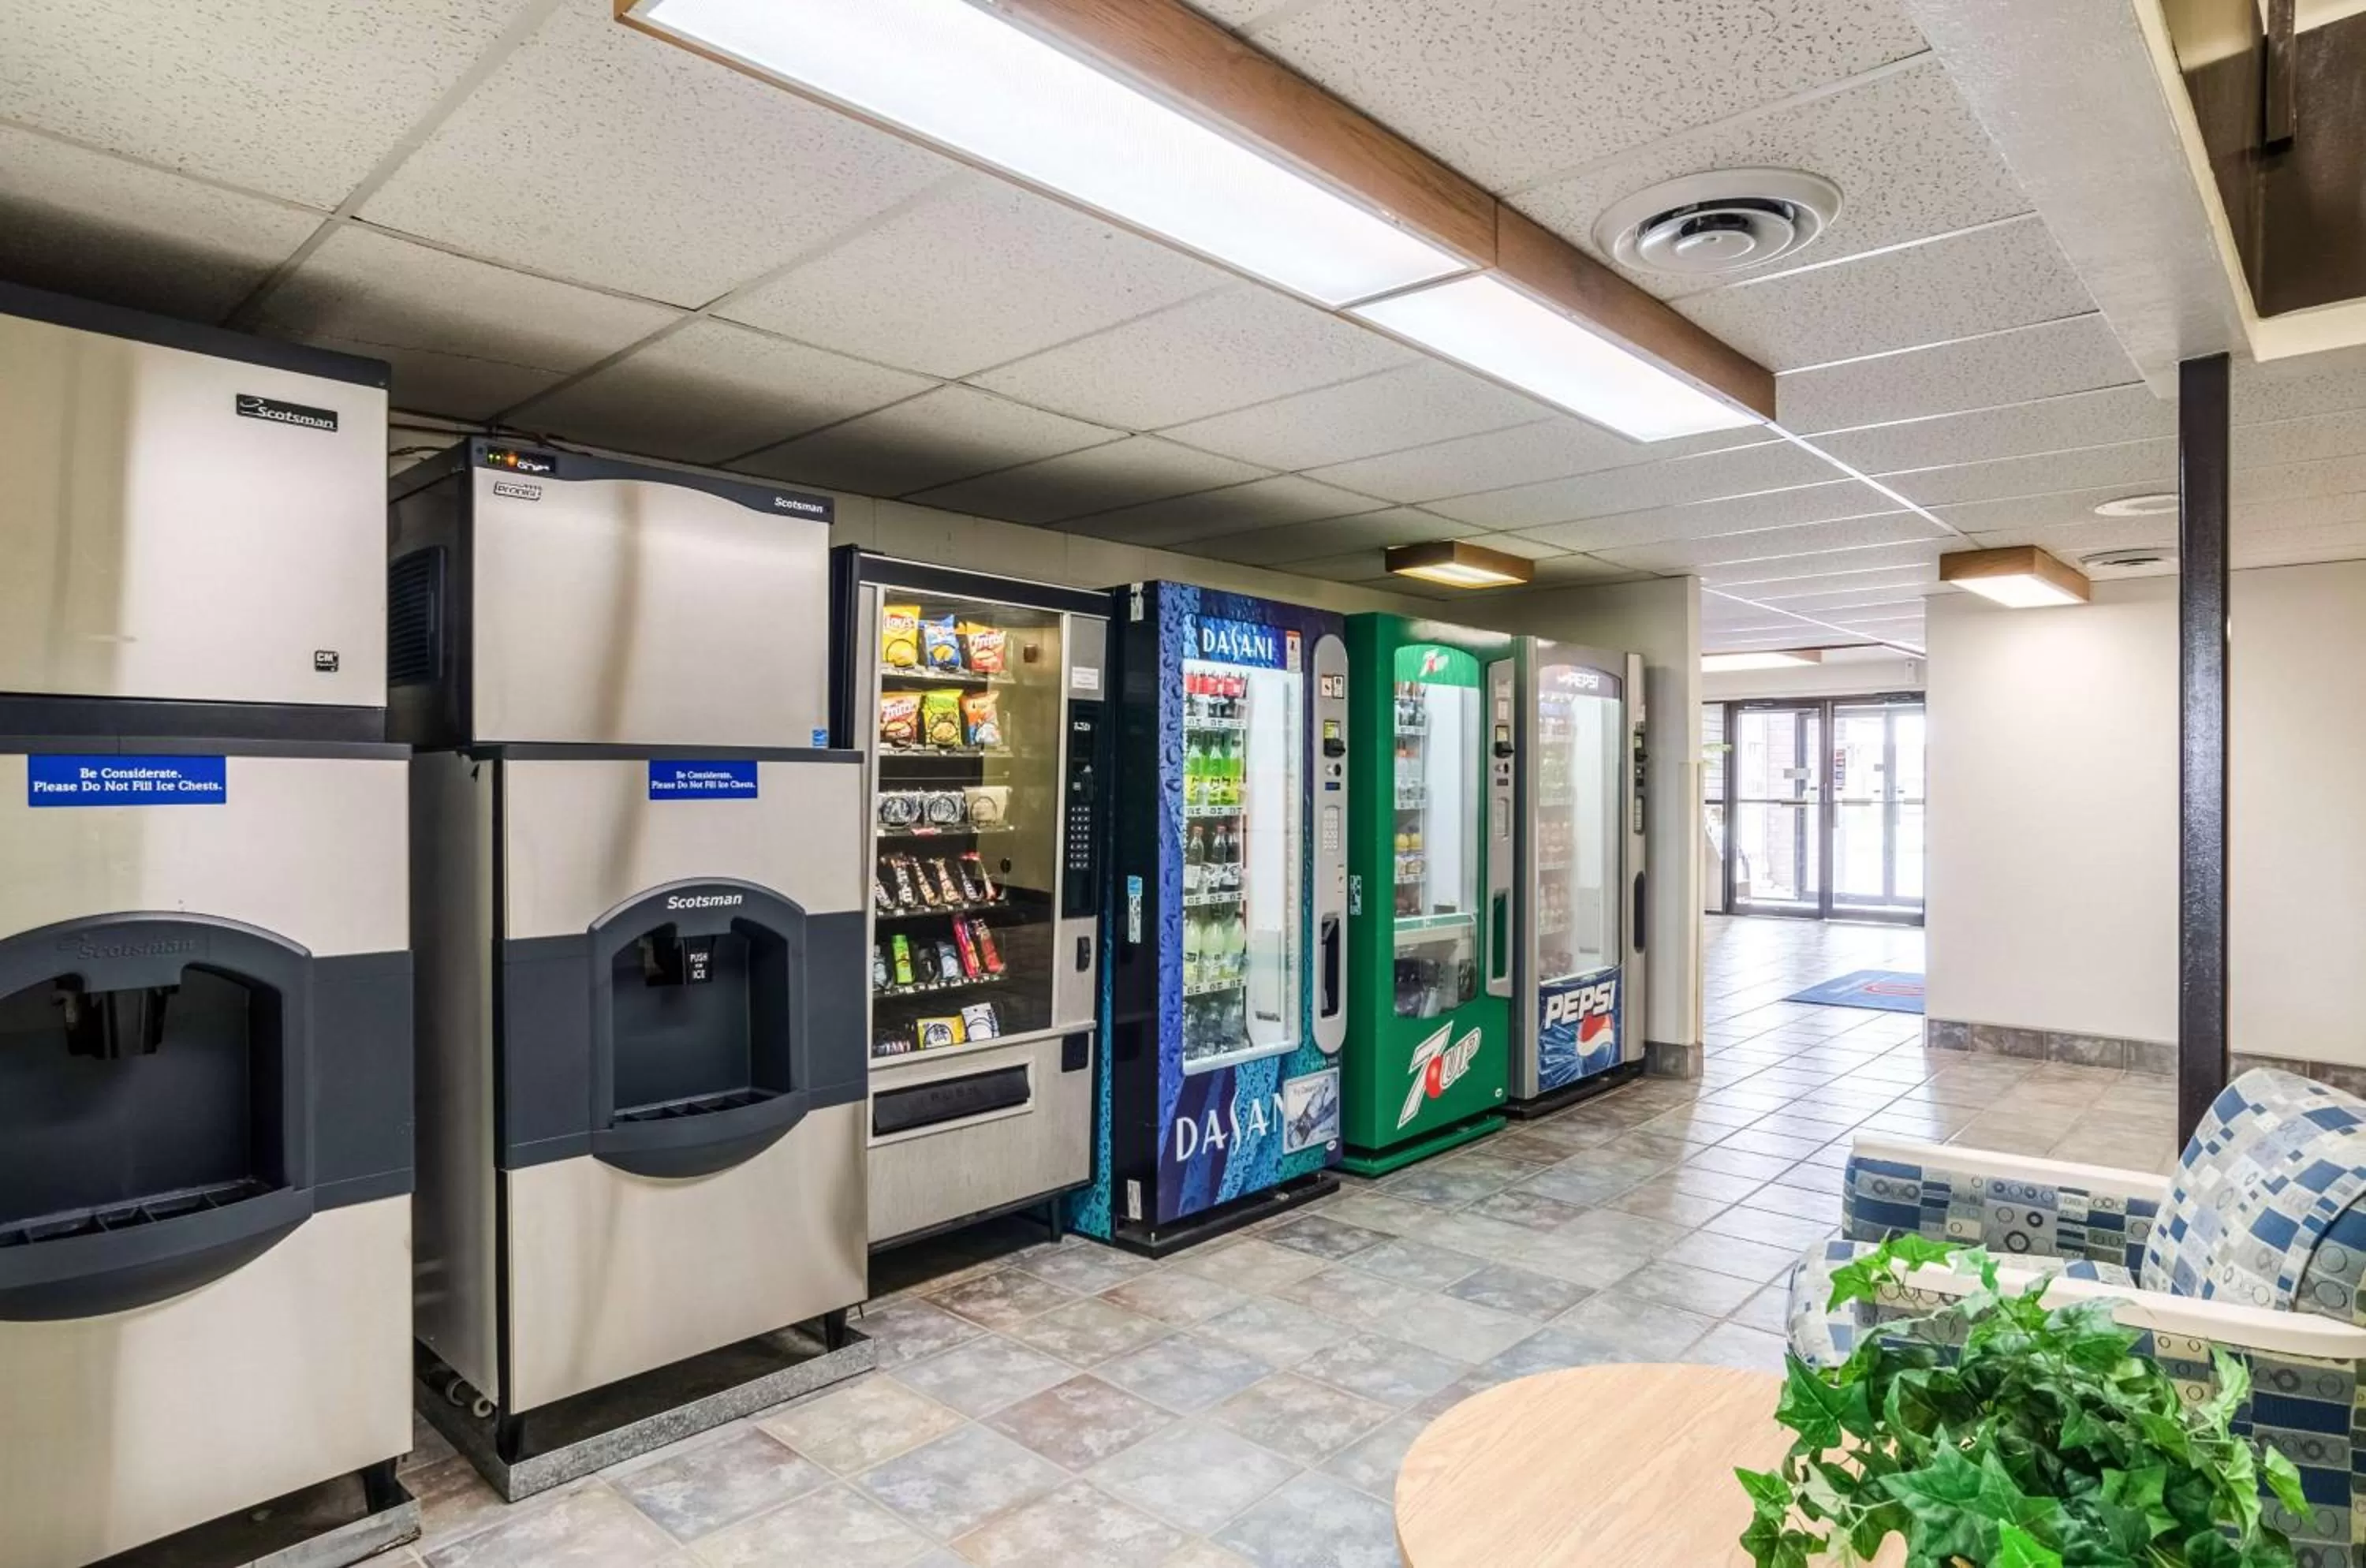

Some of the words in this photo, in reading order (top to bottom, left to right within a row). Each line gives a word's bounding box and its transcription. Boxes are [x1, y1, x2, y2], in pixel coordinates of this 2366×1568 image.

[257, 405, 335, 430] Scotsman
[774, 497, 824, 514] Scotsman
[1202, 625, 1273, 661] DASANI
[1569, 673, 1599, 691] PEPSI
[79, 767, 98, 779] Be
[100, 767, 183, 779] Considerate.
[33, 781, 78, 793] Please
[81, 781, 101, 792] Do
[104, 781, 129, 792] Not
[132, 780, 153, 791] Fill
[155, 780, 175, 791] Ice
[177, 779, 223, 791] Chests.
[666, 893, 743, 909] Scotsman
[689, 952, 708, 963] PUSH
[692, 969, 706, 980] ICE
[1544, 980, 1617, 1030] PEPSI
[1175, 1091, 1284, 1162] DASAN
